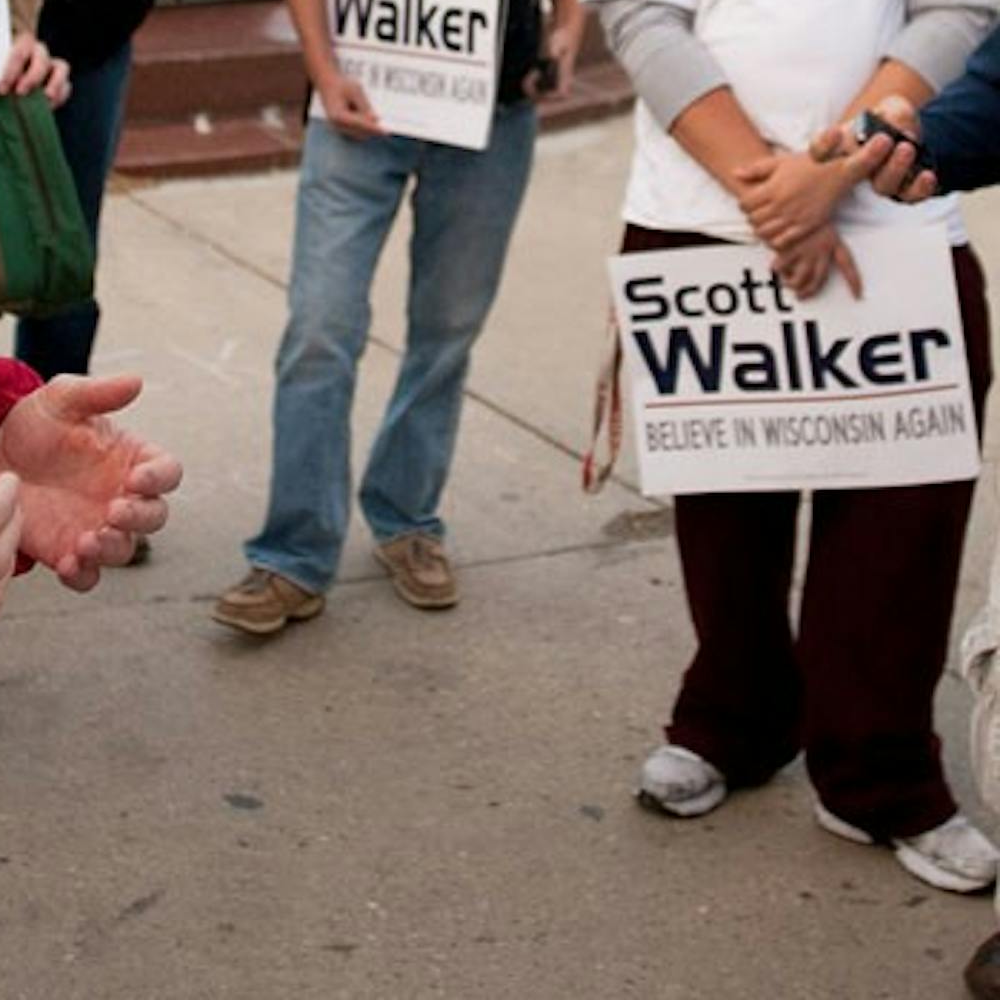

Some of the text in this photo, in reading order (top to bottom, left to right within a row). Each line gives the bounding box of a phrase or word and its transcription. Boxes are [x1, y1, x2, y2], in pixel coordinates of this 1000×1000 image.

[624, 268, 794, 323] Scott
[632, 320, 952, 396] Walker
[646, 403, 967, 451] BELIEVE IN WISCONSIN AGAIN
